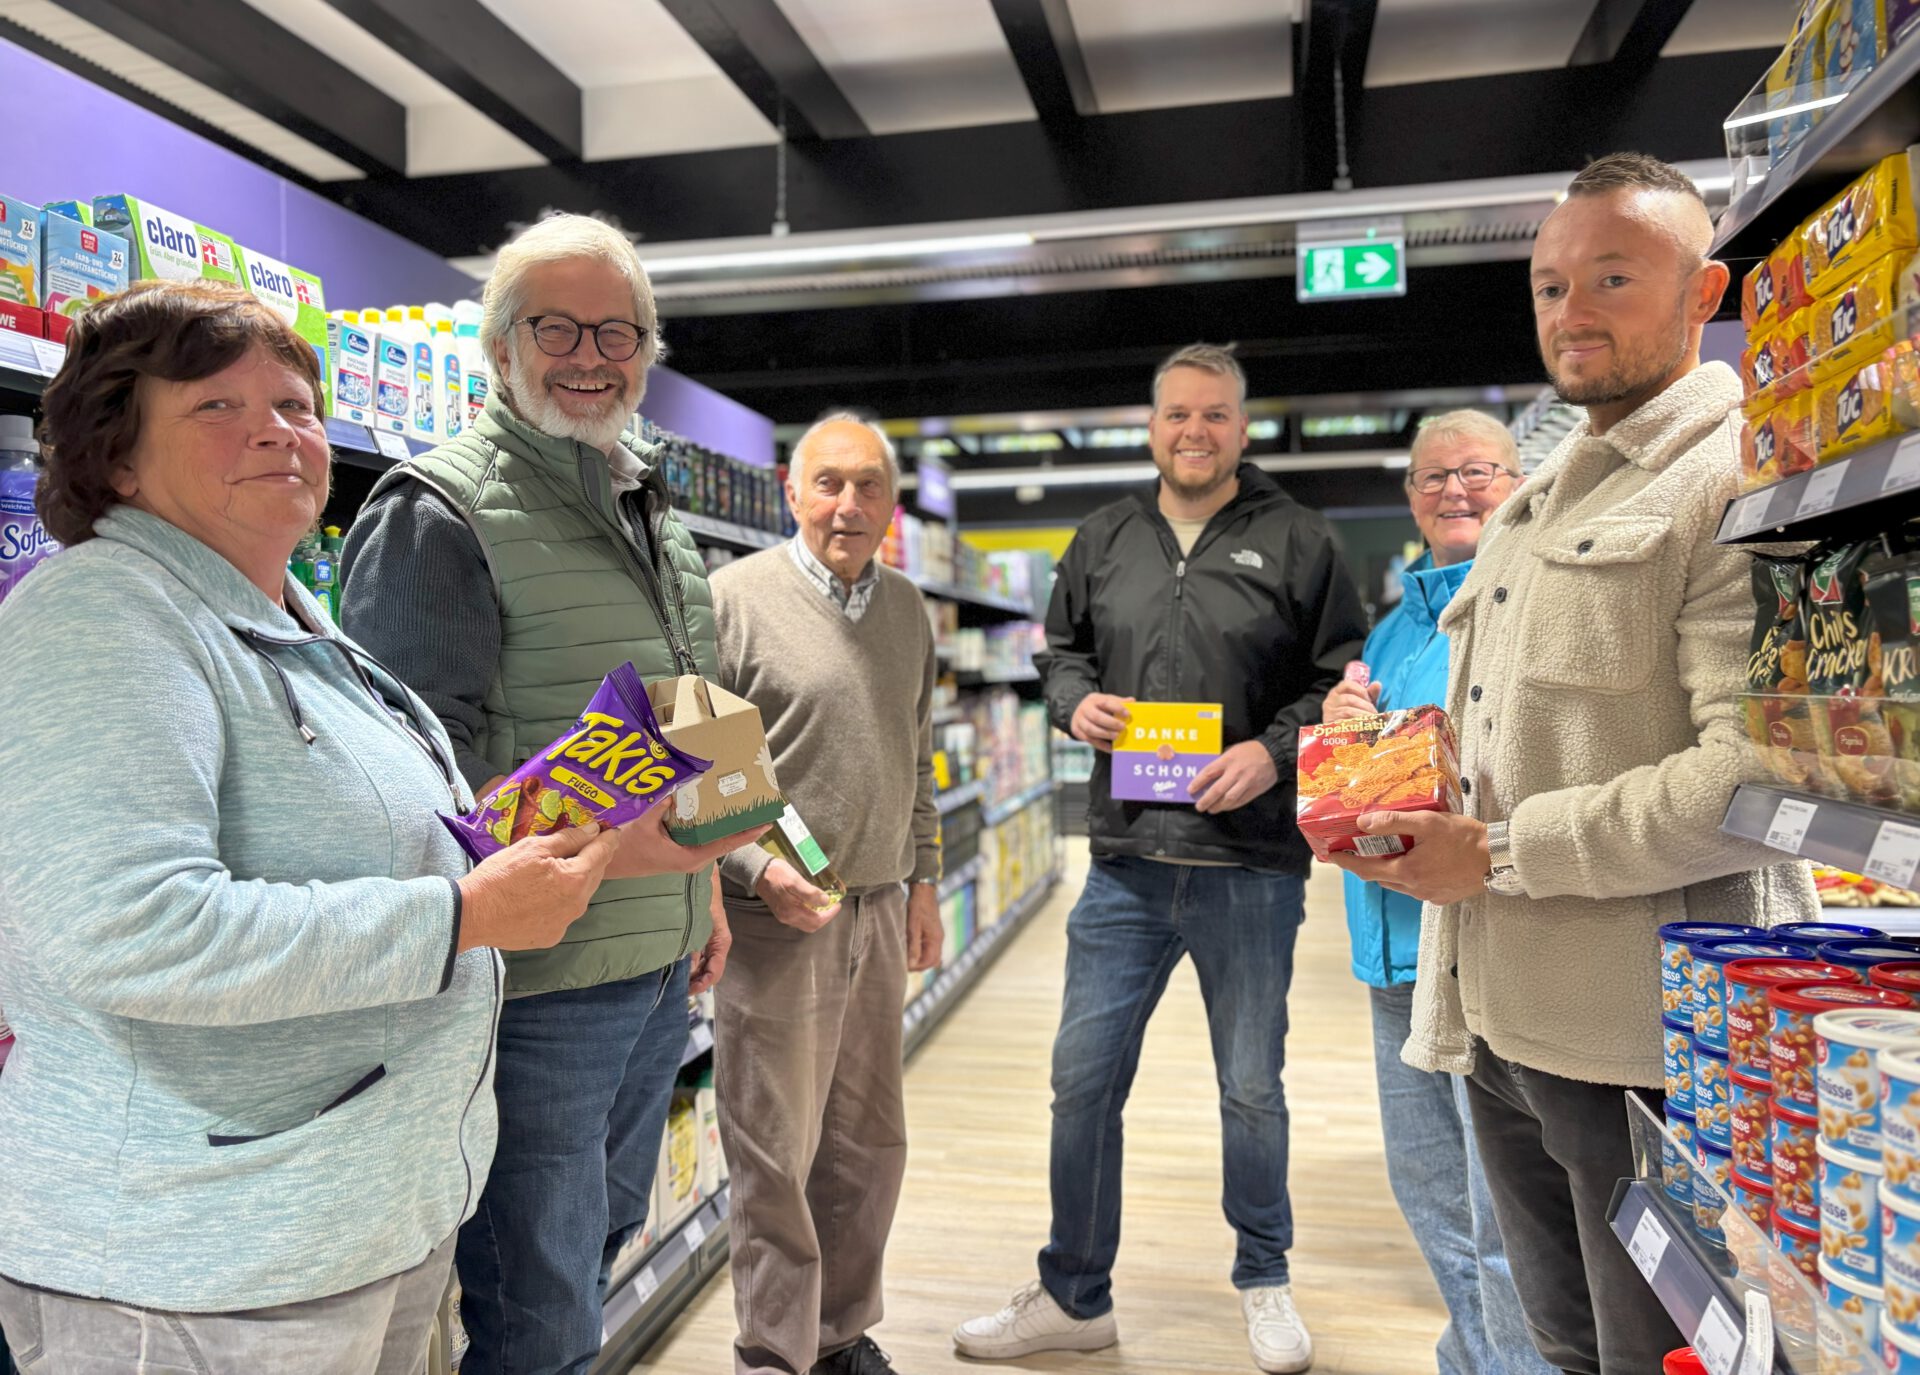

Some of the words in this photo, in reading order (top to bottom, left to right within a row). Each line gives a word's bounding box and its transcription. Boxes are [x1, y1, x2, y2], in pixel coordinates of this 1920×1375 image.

[24, 221, 33, 234] 24
[146, 216, 198, 259] claro
[1828, 212, 1853, 252] TUC
[114, 251, 122, 264] 24
[250, 261, 293, 298] claro
[1755, 276, 1773, 310] TUC
[1833, 304, 1855, 343] TUC
[1837, 389, 1860, 427] TUC
[1755, 431, 1774, 461] TUC
[1135, 726, 1198, 741] DANKE
[1322, 737, 1348, 746] 600g
[567, 775, 599, 799] FUEGO
